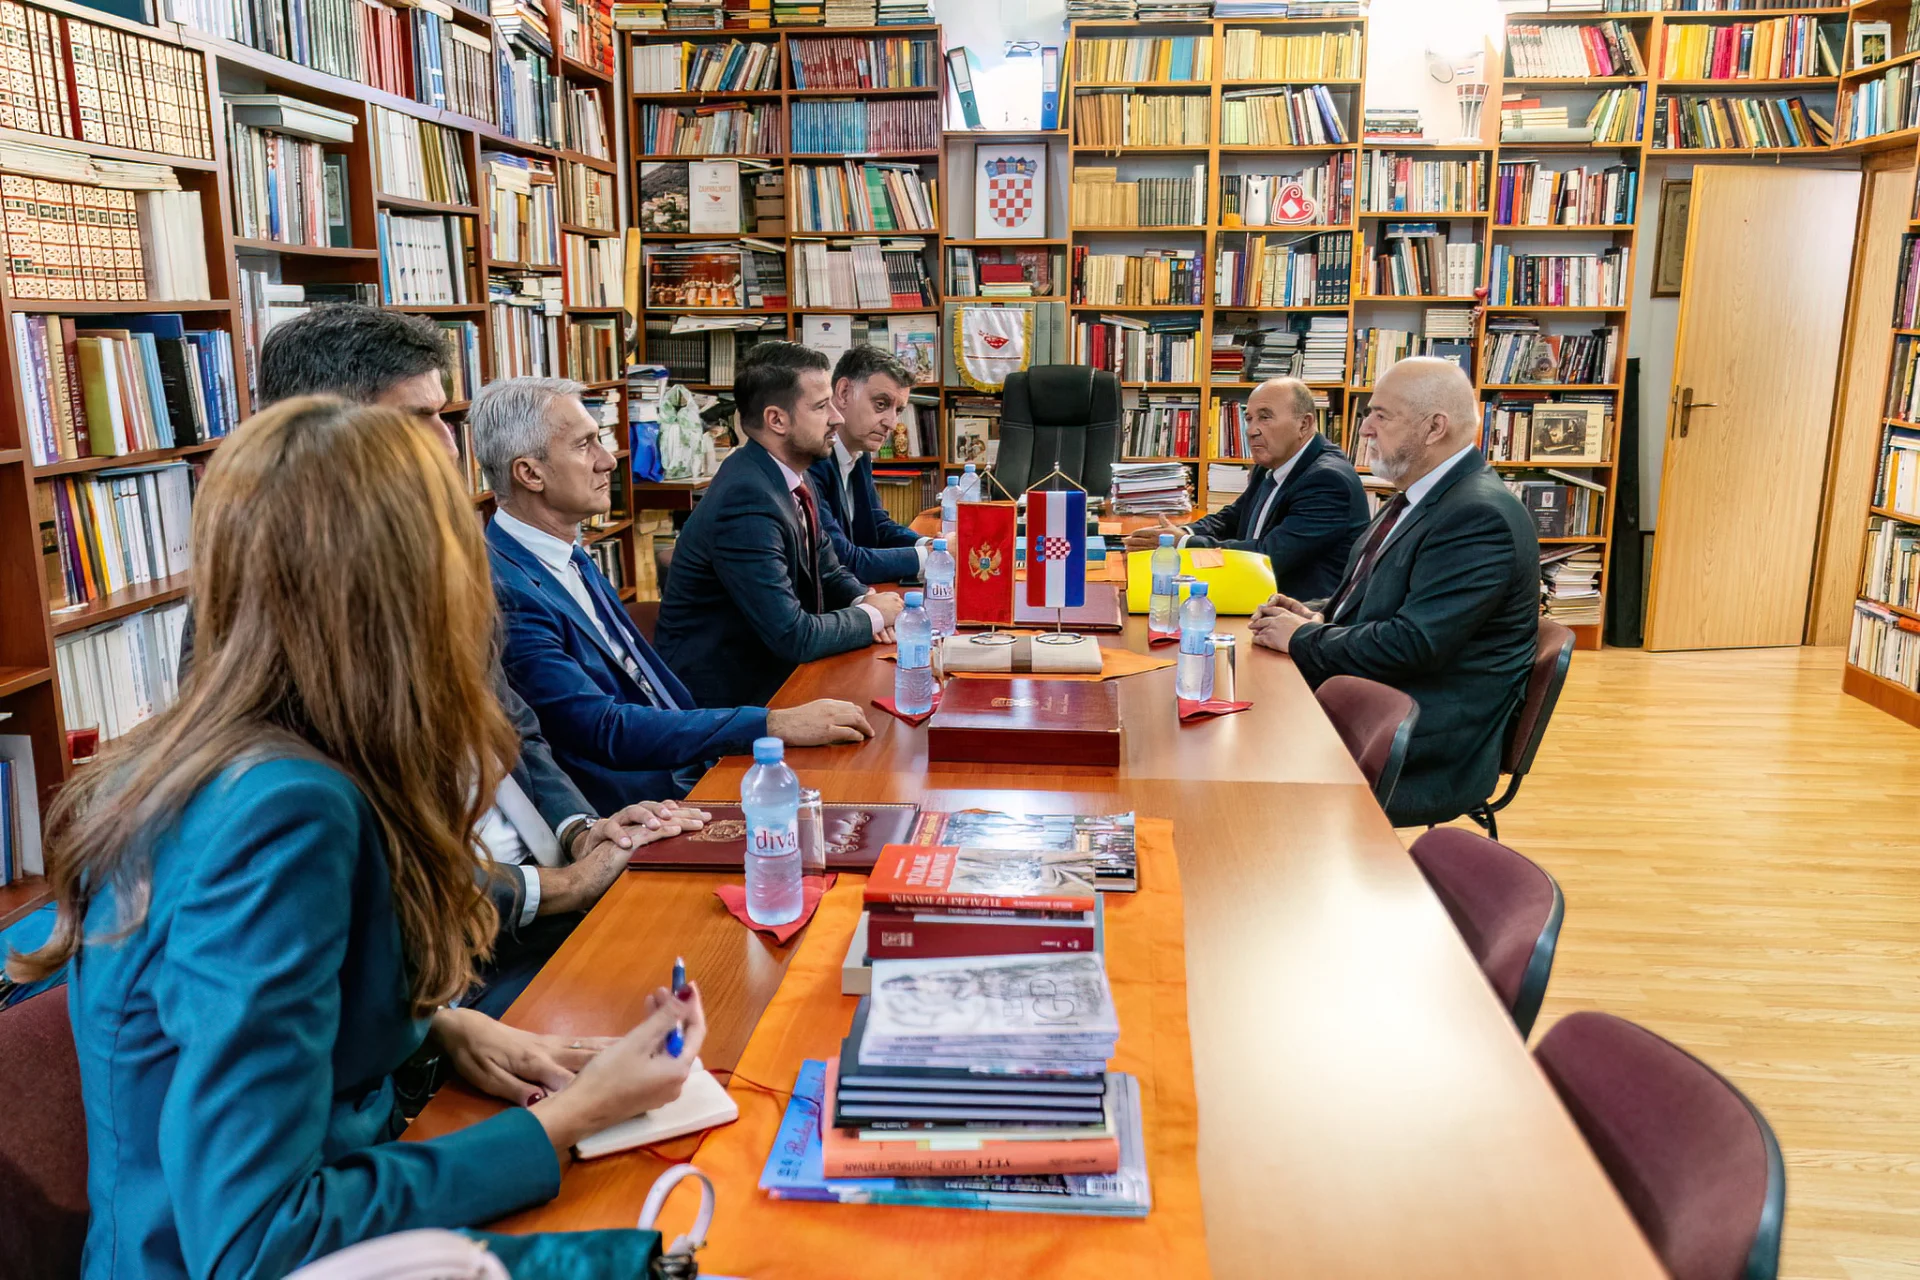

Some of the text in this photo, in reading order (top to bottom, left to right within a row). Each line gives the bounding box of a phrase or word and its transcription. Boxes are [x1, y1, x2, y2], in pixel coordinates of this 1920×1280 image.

[68, 354, 82, 426] DESETI KONGRES
[64, 408, 76, 440] IVAN
[756, 829, 796, 850] diva
